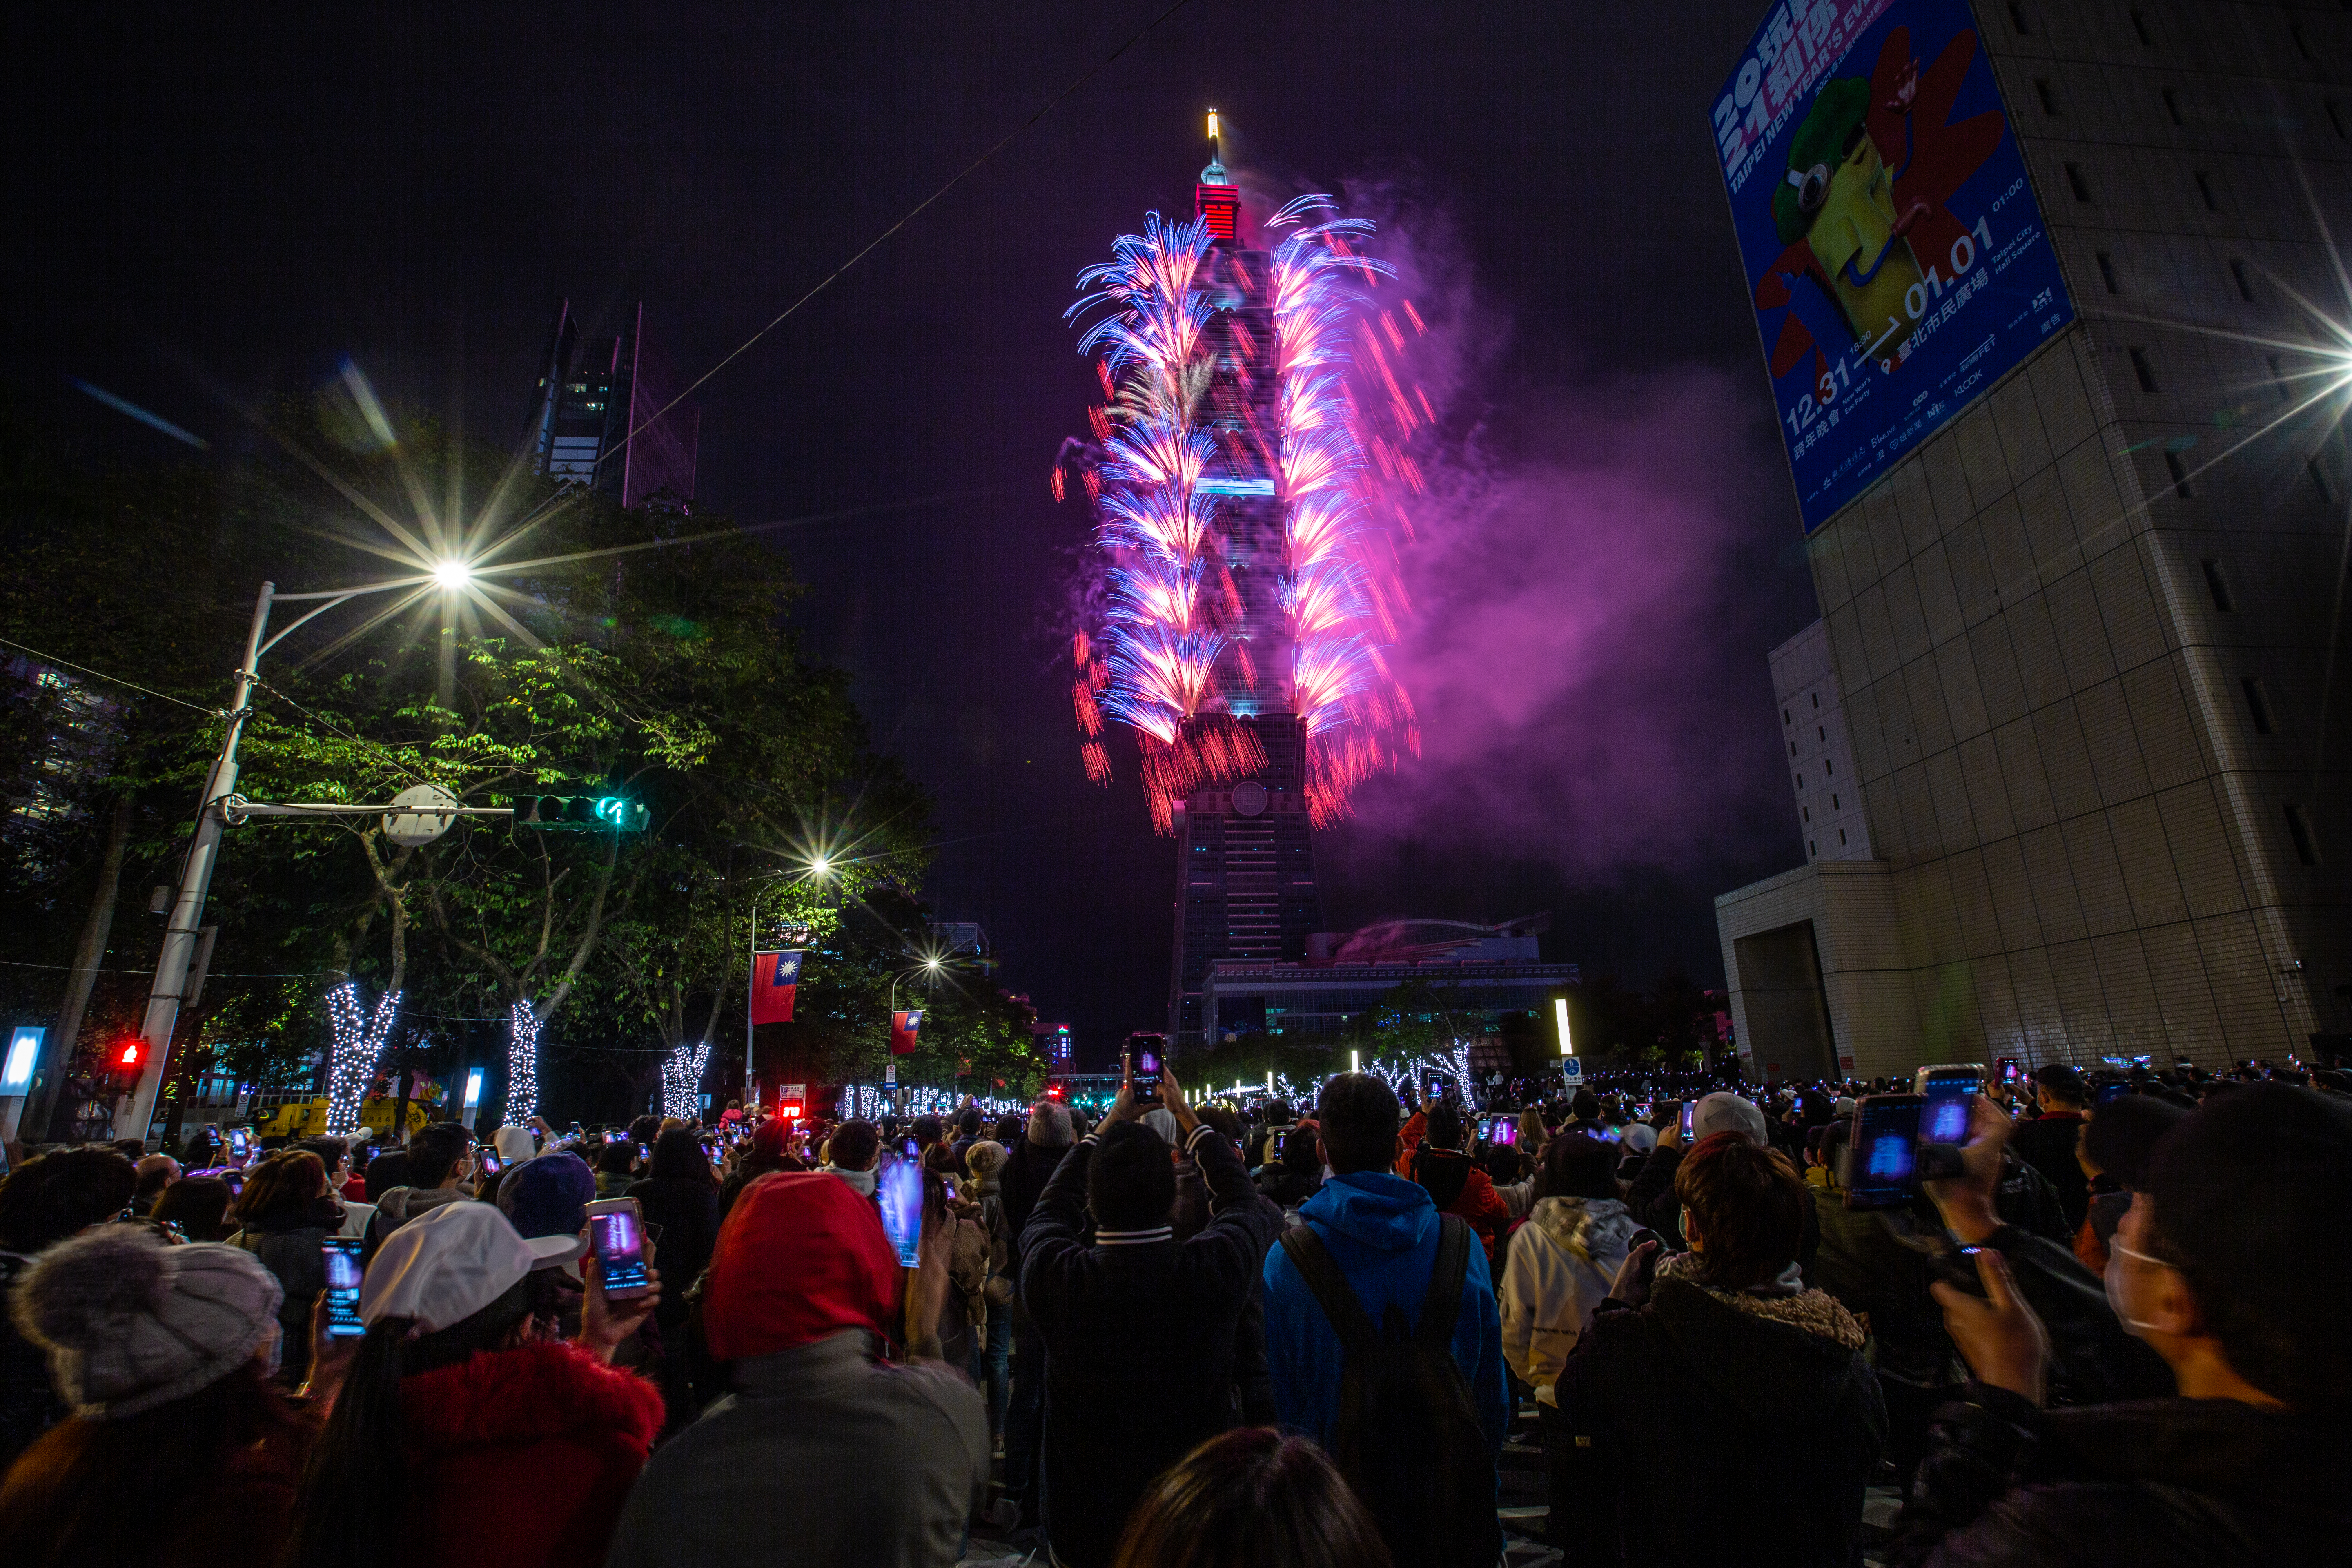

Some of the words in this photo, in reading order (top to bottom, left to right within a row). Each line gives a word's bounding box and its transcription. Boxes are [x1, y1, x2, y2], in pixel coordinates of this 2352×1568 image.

[1731, 138, 1766, 195] TAIPEI
[1766, 100, 1794, 145] NEW
[1793, 27, 1843, 101] YEAR'S
[1843, 0, 1870, 33] EV
[1992, 178, 2024, 212] 01:00
[1991, 239, 2016, 264] Taipei
[2016, 224, 2033, 242] City
[1995, 257, 2011, 275] Hall
[2011, 231, 2041, 261] Square
[1904, 215, 1993, 320] 01.01
[1897, 267, 1989, 363] 臺北市民廣場
[2041, 312, 2061, 335] 廣告
[1849, 330, 1871, 356] 18:30
[1978, 338, 1996, 358] FET
[1786, 356, 1850, 436] 12.31
[1842, 392, 1855, 406] New
[1854, 377, 1871, 396] Year's
[1844, 401, 1855, 415] Eve
[1854, 388, 1870, 405] Party
[1954, 369, 1983, 397] KLOOK
[1793, 408, 1840, 461] 跨年晚會
